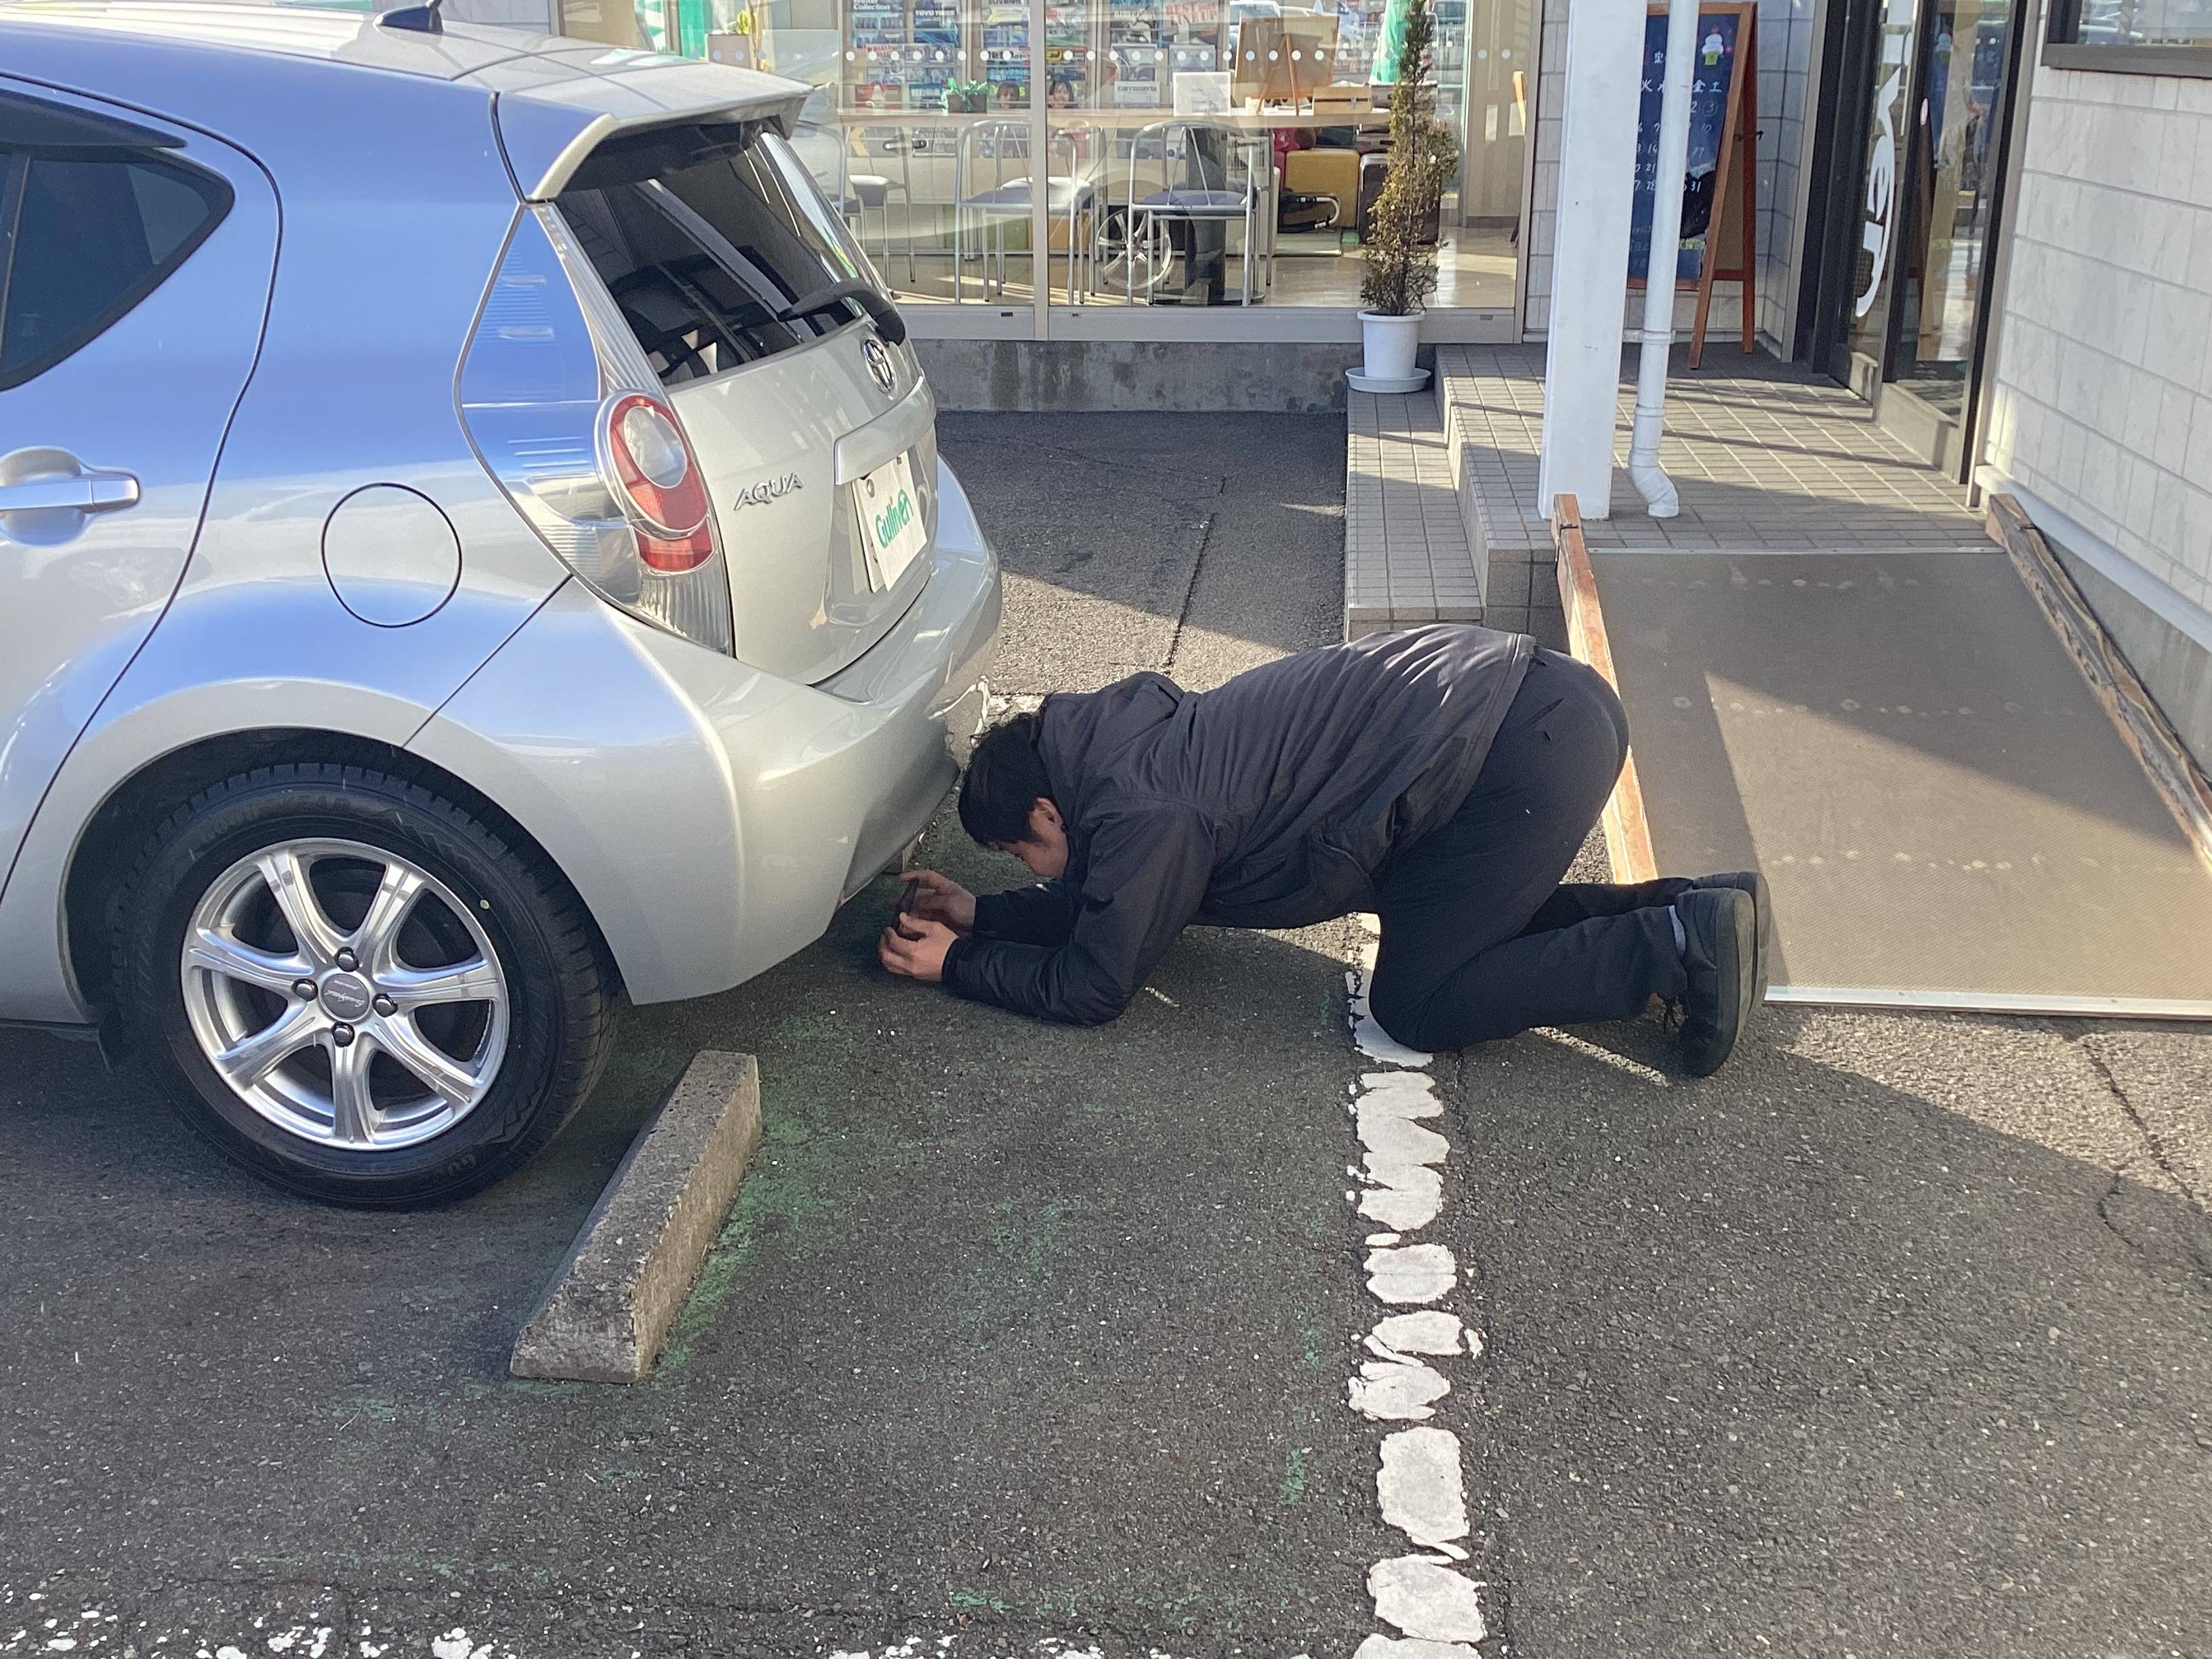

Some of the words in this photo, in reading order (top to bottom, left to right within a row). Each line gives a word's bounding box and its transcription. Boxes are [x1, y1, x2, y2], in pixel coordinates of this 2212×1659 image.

[1641, 79, 1653, 93] 火
[1693, 79, 1706, 93] 金
[1709, 81, 1722, 93] 土
[1691, 101, 1698, 113] 2
[1645, 163, 1656, 173] 21
[1692, 181, 1701, 192] 31
[734, 472, 803, 510] AQUA
[876, 489, 914, 549] Gulliver
